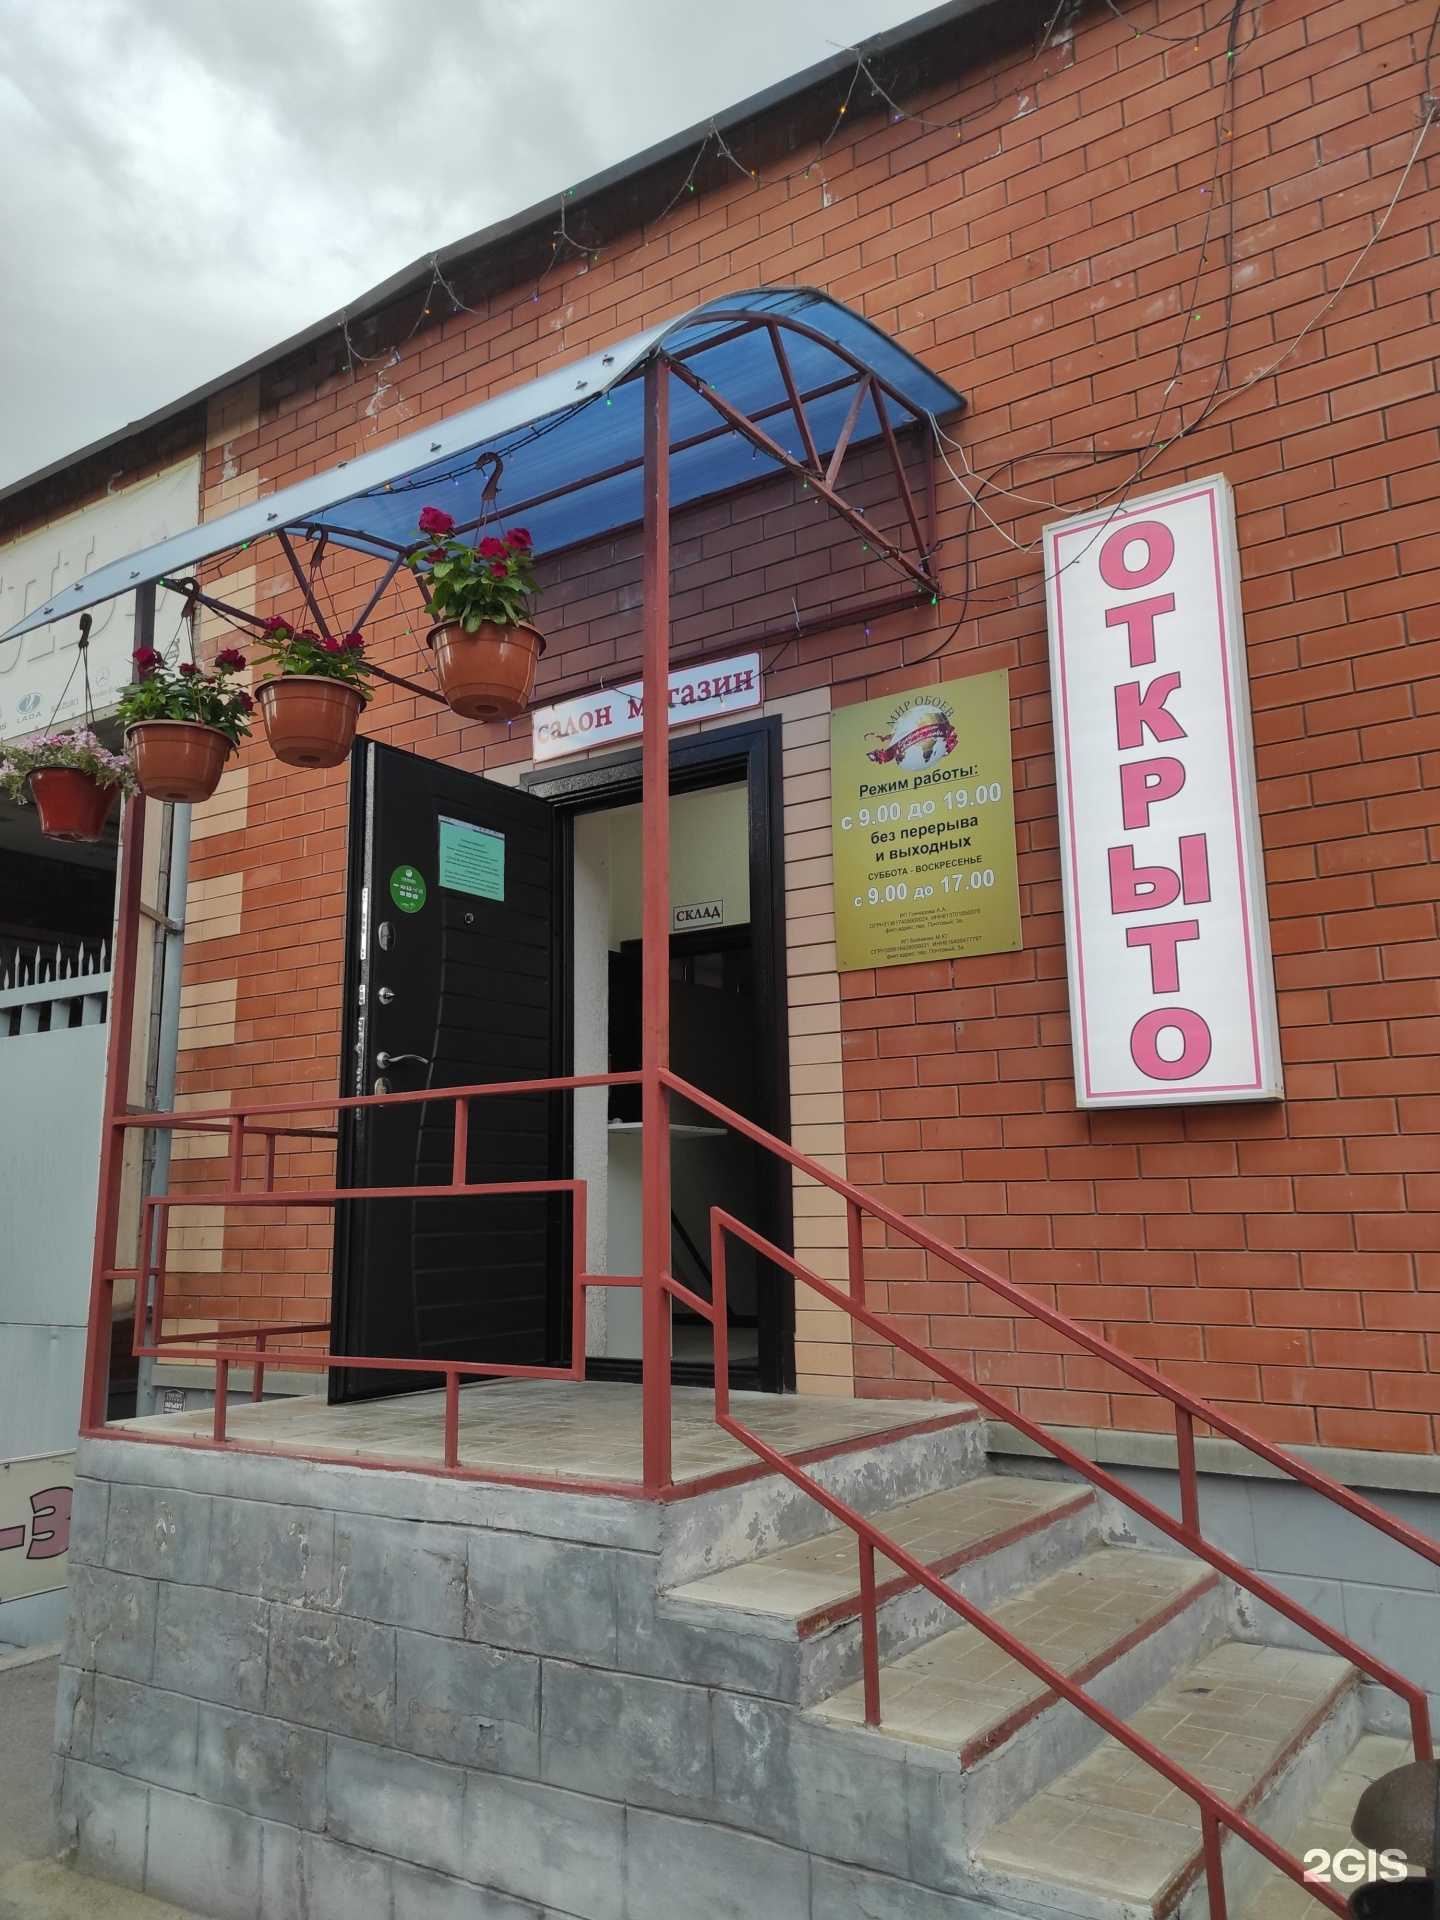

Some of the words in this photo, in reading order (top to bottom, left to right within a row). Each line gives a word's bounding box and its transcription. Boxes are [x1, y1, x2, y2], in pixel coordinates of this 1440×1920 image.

[537, 705, 612, 744] салон
[628, 669, 755, 719] мгазин
[886, 700, 911, 724] МИР
[859, 778, 909, 798] Режим
[913, 764, 979, 789] работы:
[858, 802, 901, 827] 9.00
[907, 800, 936, 821] до
[943, 782, 1002, 810] 19.00
[1099, 520, 1212, 1081] ОТКРЫТО
[871, 830, 896, 845] без
[900, 816, 979, 840] перерыва
[875, 851, 885, 863] и
[889, 836, 972, 861] выходных
[868, 867, 908, 881] СУББОТА
[915, 854, 983, 873] ВОСКРЕСЕНЬЕ
[868, 882, 907, 905] 9.00
[913, 885, 934, 901] до
[941, 869, 995, 893] 17.00
[676, 905, 721, 922] СКЛАД
